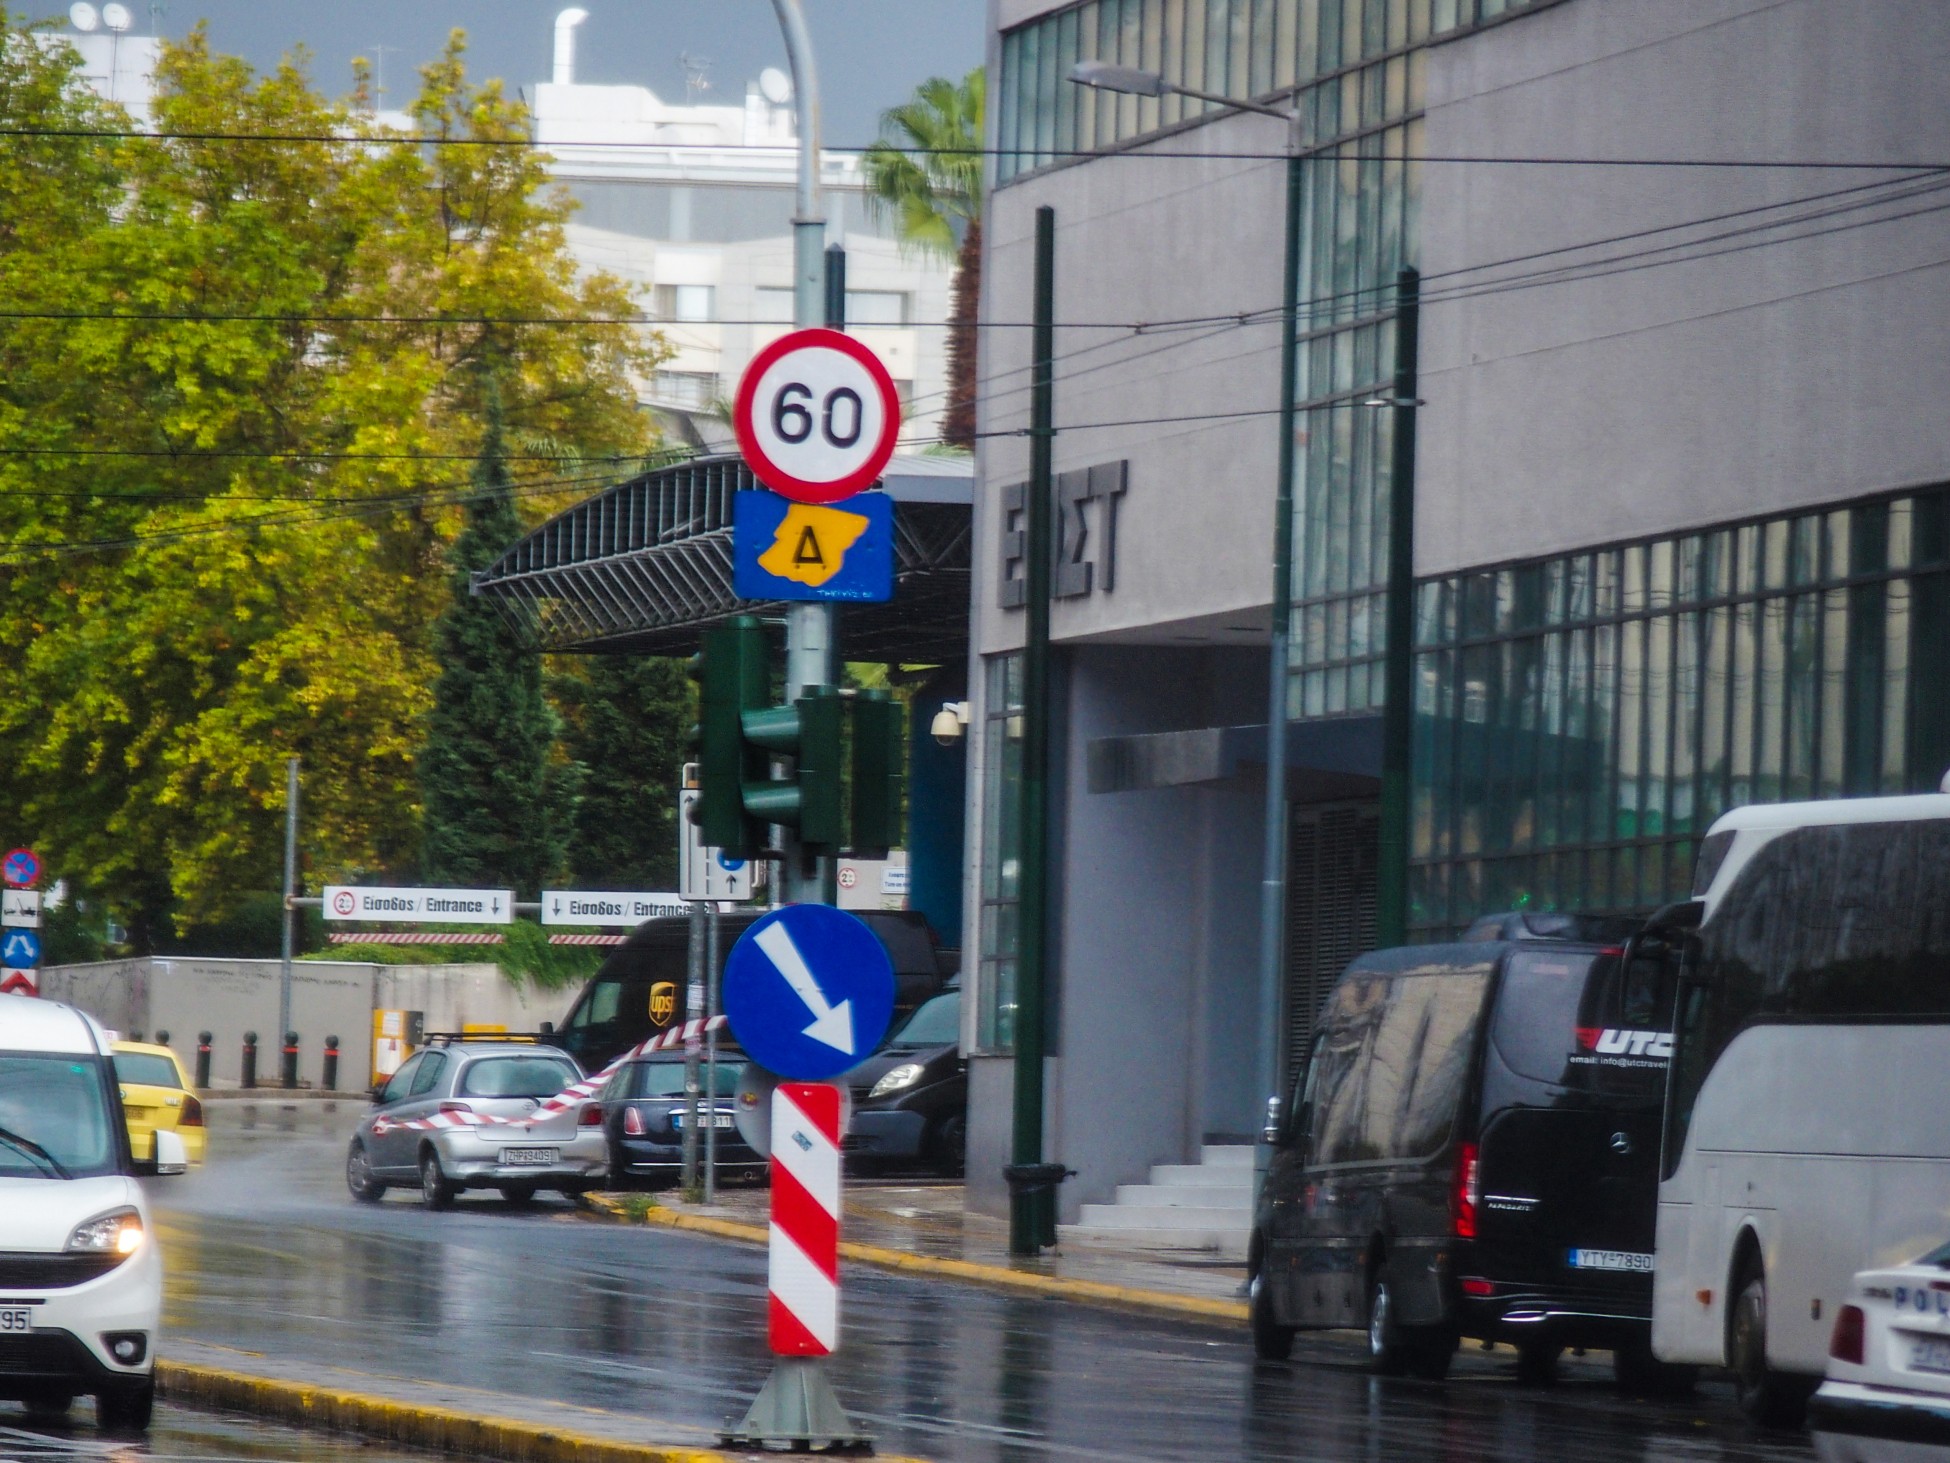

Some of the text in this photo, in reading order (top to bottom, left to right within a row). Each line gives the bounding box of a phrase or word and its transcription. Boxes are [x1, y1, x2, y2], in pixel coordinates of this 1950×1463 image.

[771, 382, 862, 449] 60
[426, 898, 483, 913] Entrance
[651, 995, 672, 1019] ups
